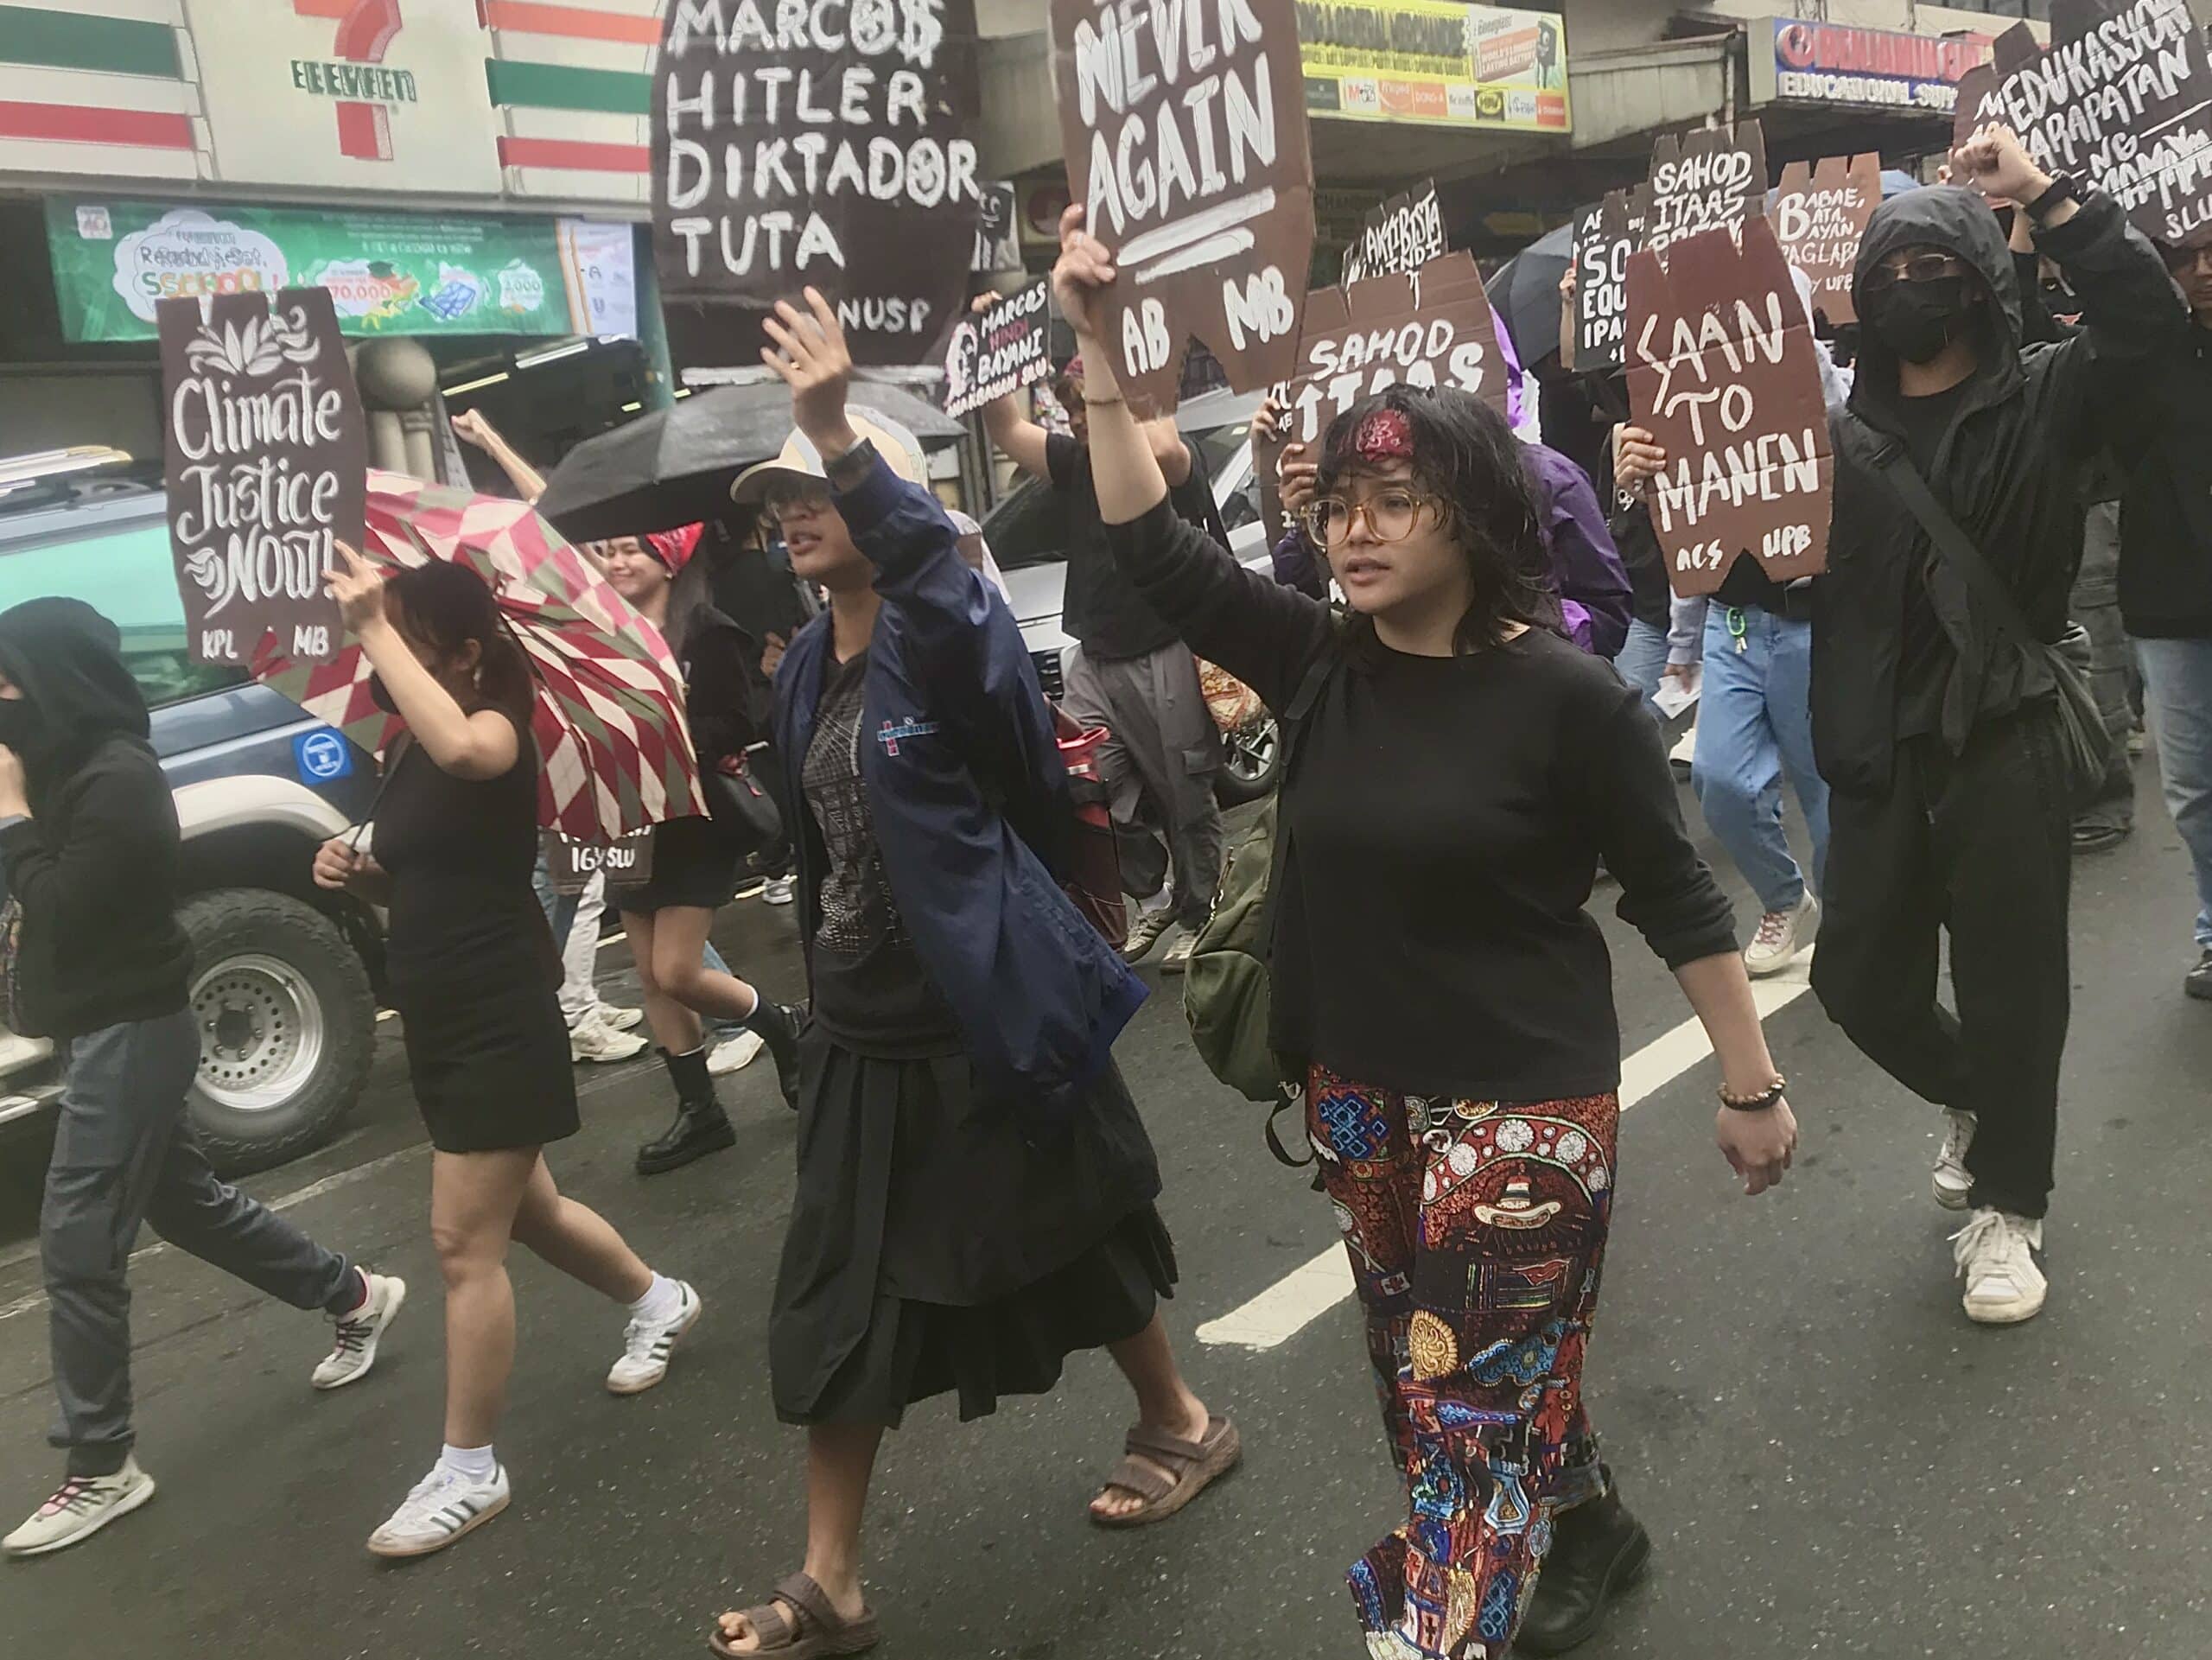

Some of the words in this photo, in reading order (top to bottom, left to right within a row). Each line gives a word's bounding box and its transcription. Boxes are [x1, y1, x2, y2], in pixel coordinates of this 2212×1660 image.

[667, 67, 927, 134] HITLER
[667, 132, 981, 209] DIKTADOR
[1086, 52, 1276, 238] AGAIN
[1654, 151, 1752, 194] SAHOD
[2089, 132, 2139, 179] NG
[1651, 175, 1753, 233] ITAAS
[670, 210, 847, 278] TUTA
[837, 296, 932, 334] NUSP
[982, 281, 1046, 338] MARCOS
[1122, 296, 1171, 378] AB
[1224, 264, 1294, 351] MB
[977, 328, 1044, 385] BAYANI
[1309, 319, 1454, 380] SAHOD
[1637, 291, 1784, 415] SAAN
[173, 366, 341, 460] Climate
[1665, 384, 1753, 446] TO
[176, 456, 340, 545] Justice
[1654, 429, 1819, 532] MANEN
[1763, 524, 1812, 558] UPB
[202, 629, 239, 659] KPL
[292, 626, 331, 657] MB
